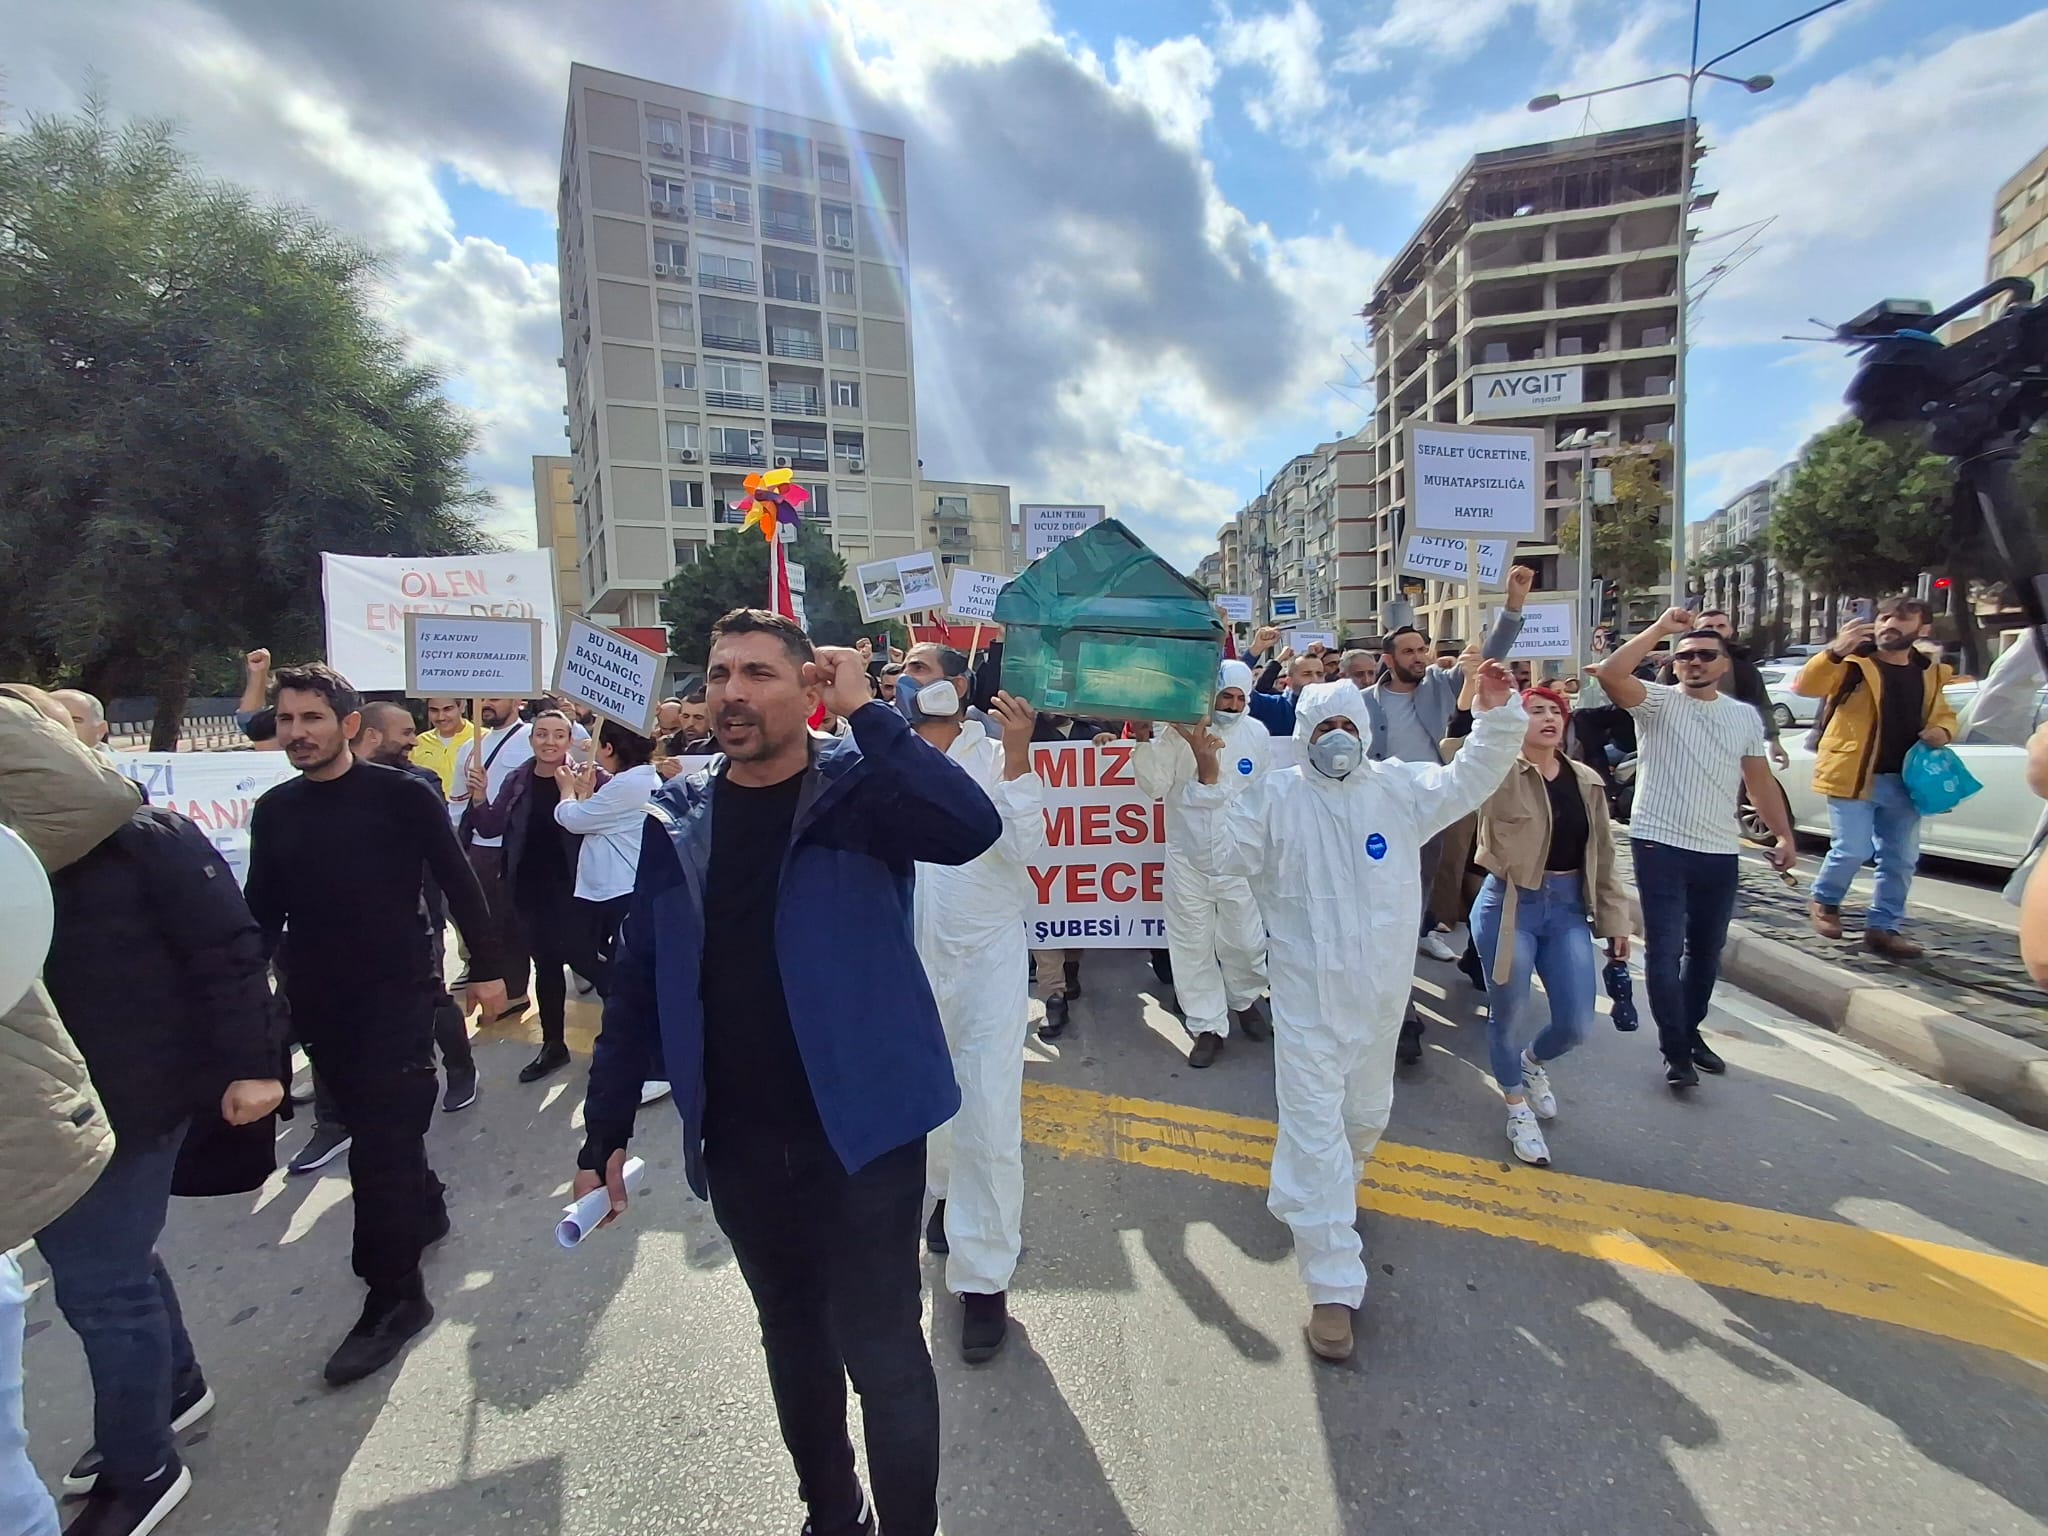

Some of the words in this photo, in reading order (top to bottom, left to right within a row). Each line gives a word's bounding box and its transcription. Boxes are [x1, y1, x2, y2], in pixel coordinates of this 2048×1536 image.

[1488, 373, 1567, 398] AYGIT
[1418, 444, 1464, 458] SEFALET
[1468, 447, 1530, 462] ÜCRETİNE,
[1424, 475, 1525, 490] MUHATAPSIZLIĞA
[1455, 507, 1493, 518] HAYIR!
[1034, 523, 1060, 531] UCUZ
[1408, 553, 1452, 569] LÜTUF
[401, 567, 488, 598] ÖLEN
[420, 632, 431, 642] İŞ
[433, 633, 479, 642] KANUNU
[455, 651, 529, 662] KORUMALIDIR,
[588, 632, 604, 647] BU
[606, 641, 638, 665] DAHA
[421, 669, 470, 677] PATRONU
[576, 646, 643, 688] BAŞLANGIÇ,
[567, 660, 646, 706] MÜCADELEYE
[581, 685, 625, 714] DEVAM!
[1034, 747, 1136, 788] MIZ
[1035, 914, 1120, 942] ŞUBESİ
